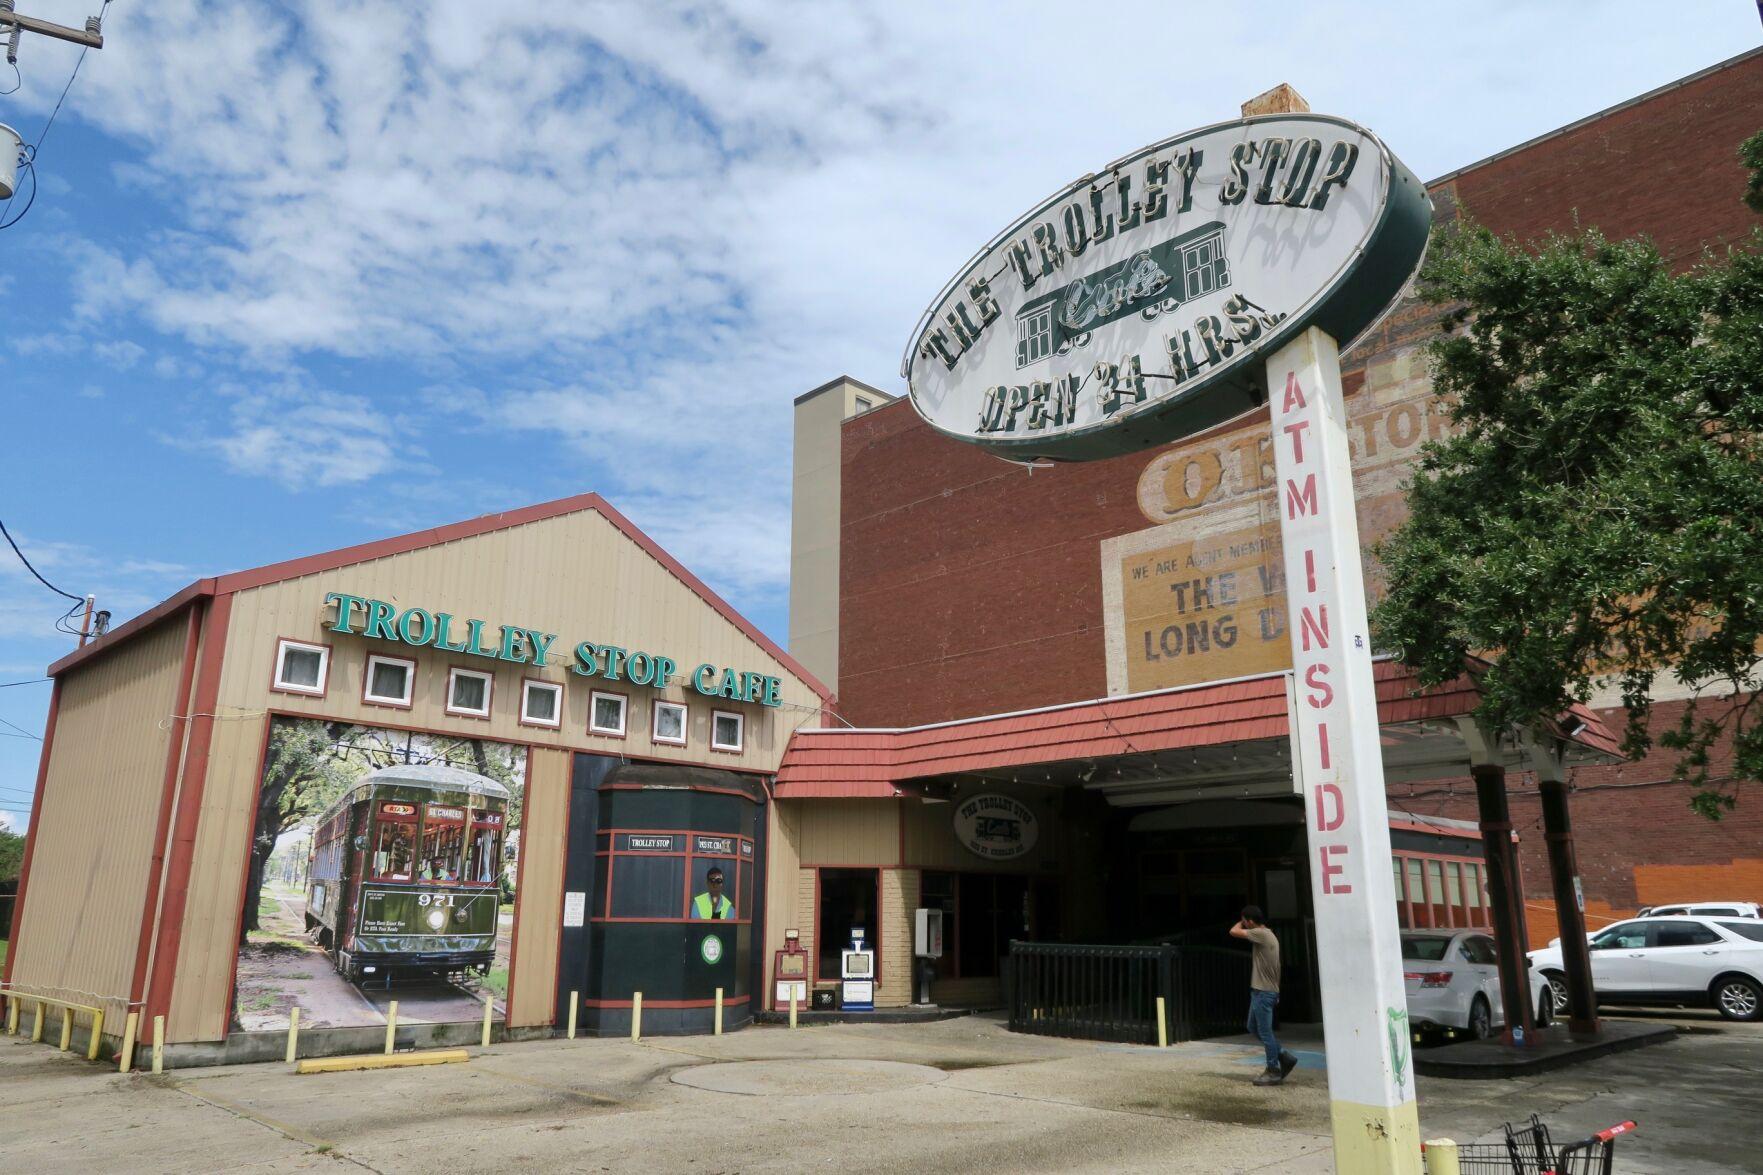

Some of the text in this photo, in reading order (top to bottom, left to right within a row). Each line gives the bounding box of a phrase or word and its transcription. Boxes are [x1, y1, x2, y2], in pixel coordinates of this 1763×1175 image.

[921, 137, 1358, 370] THE TROLLEY STOP
[975, 372, 1080, 434] OPEN
[1094, 353, 1146, 420] 24
[1132, 566, 1150, 580] WE
[1155, 559, 1179, 575] ARE
[1170, 571, 1237, 615] THE
[326, 592, 785, 708] TROLLEY STOP CAFE
[1144, 614, 1238, 662] LONG
[1282, 371, 1353, 895] ATM INSIDE
[631, 839, 669, 848] TROLLEY STOP
[418, 894, 455, 908] 971
